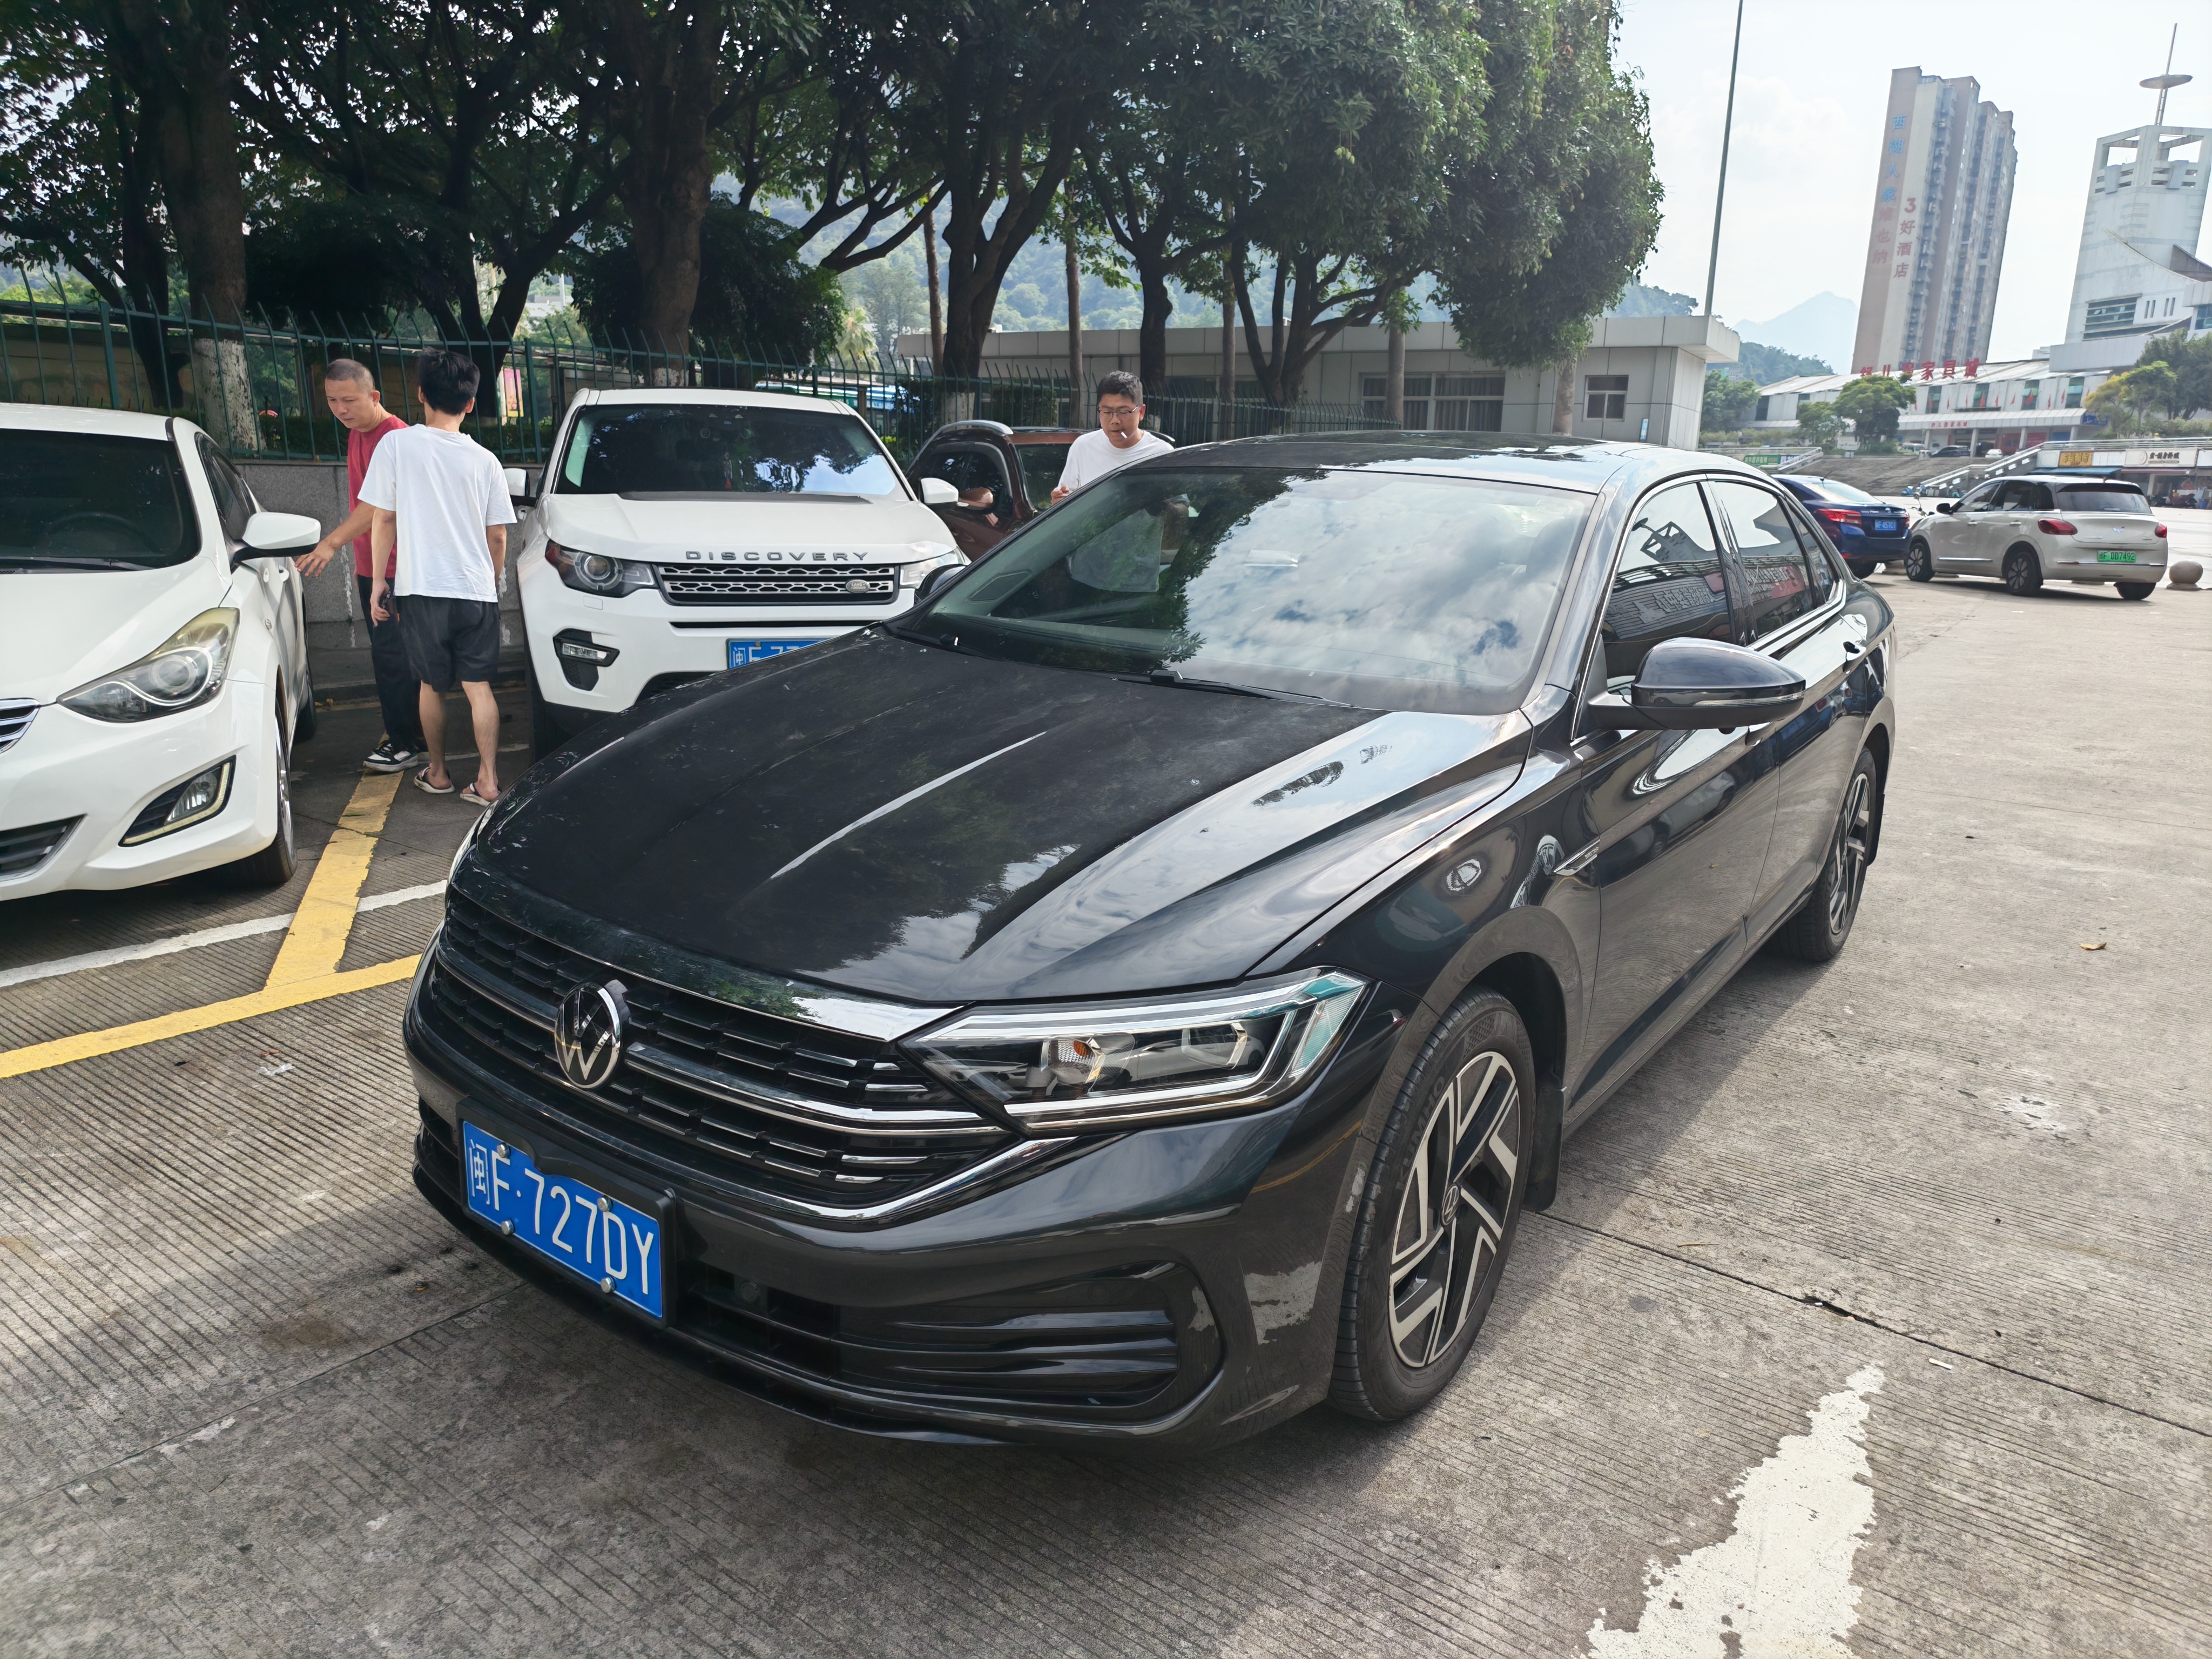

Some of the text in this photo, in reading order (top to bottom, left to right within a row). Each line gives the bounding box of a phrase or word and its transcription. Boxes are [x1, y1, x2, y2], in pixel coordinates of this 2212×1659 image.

[1881, 114, 1907, 202] 西湖人家
[1893, 198, 1916, 278] 3好酒店
[685, 550, 868, 562] DISCOVERY
[1395, 1076, 1445, 1191] KUMHO
